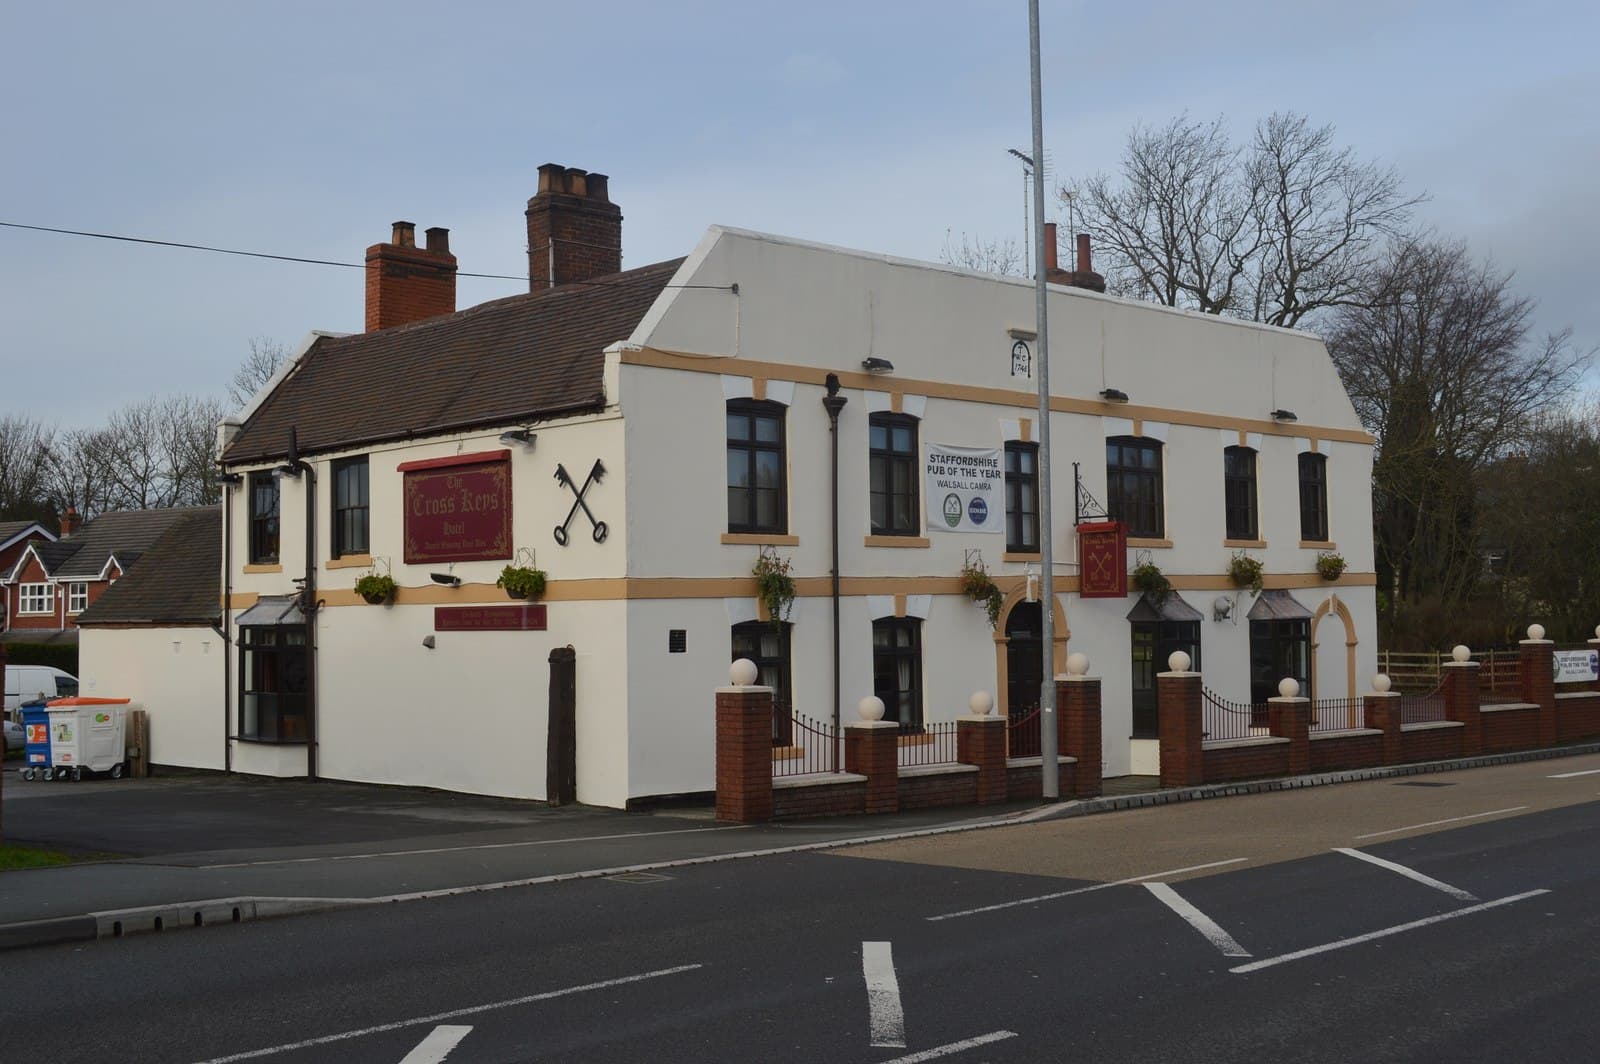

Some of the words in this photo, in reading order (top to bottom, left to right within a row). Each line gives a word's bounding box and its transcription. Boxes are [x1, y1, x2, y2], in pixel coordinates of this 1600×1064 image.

[930, 454, 998, 467] STAFFORDSHIRE
[927, 465, 945, 475] PUB
[947, 467, 958, 476] OF
[960, 468, 977, 477] THE
[979, 469, 1001, 479] YEAR
[448, 476, 463, 489] The
[937, 480, 969, 490] WALSALL
[970, 482, 992, 491] CAMRA
[414, 494, 456, 517] Cross
[461, 489, 499, 517] Keys
